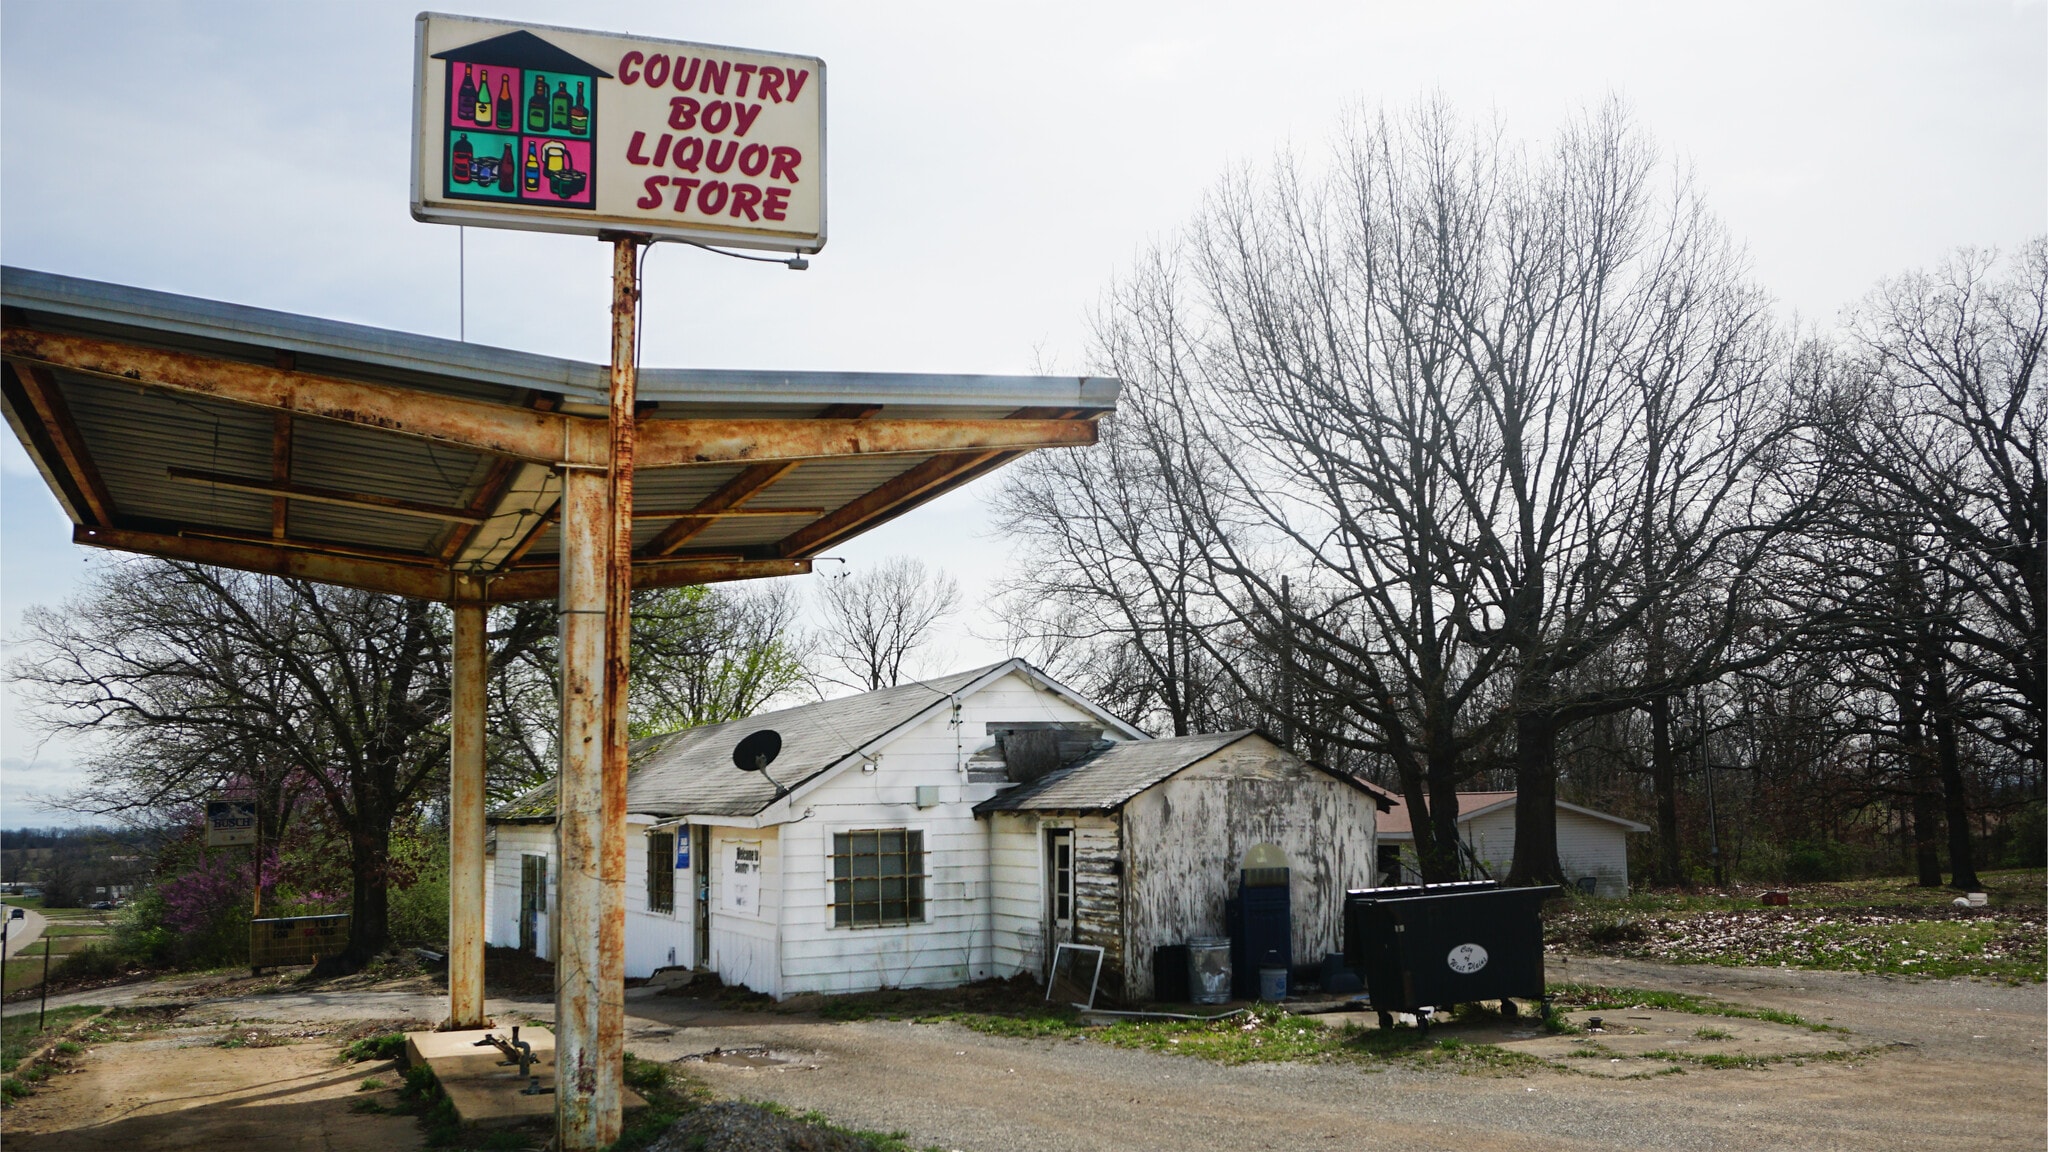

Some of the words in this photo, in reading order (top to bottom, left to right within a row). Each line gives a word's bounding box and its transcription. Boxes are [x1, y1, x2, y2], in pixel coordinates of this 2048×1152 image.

[618, 50, 809, 105] COUNTRY
[667, 95, 763, 138] BOY
[625, 130, 803, 185] LIQUOR
[637, 175, 793, 222] STORE
[214, 818, 250, 828] BUSCH
[1450, 958, 1466, 971] West
[1467, 956, 1487, 970] Plains
[1460, 945, 1474, 953] City
